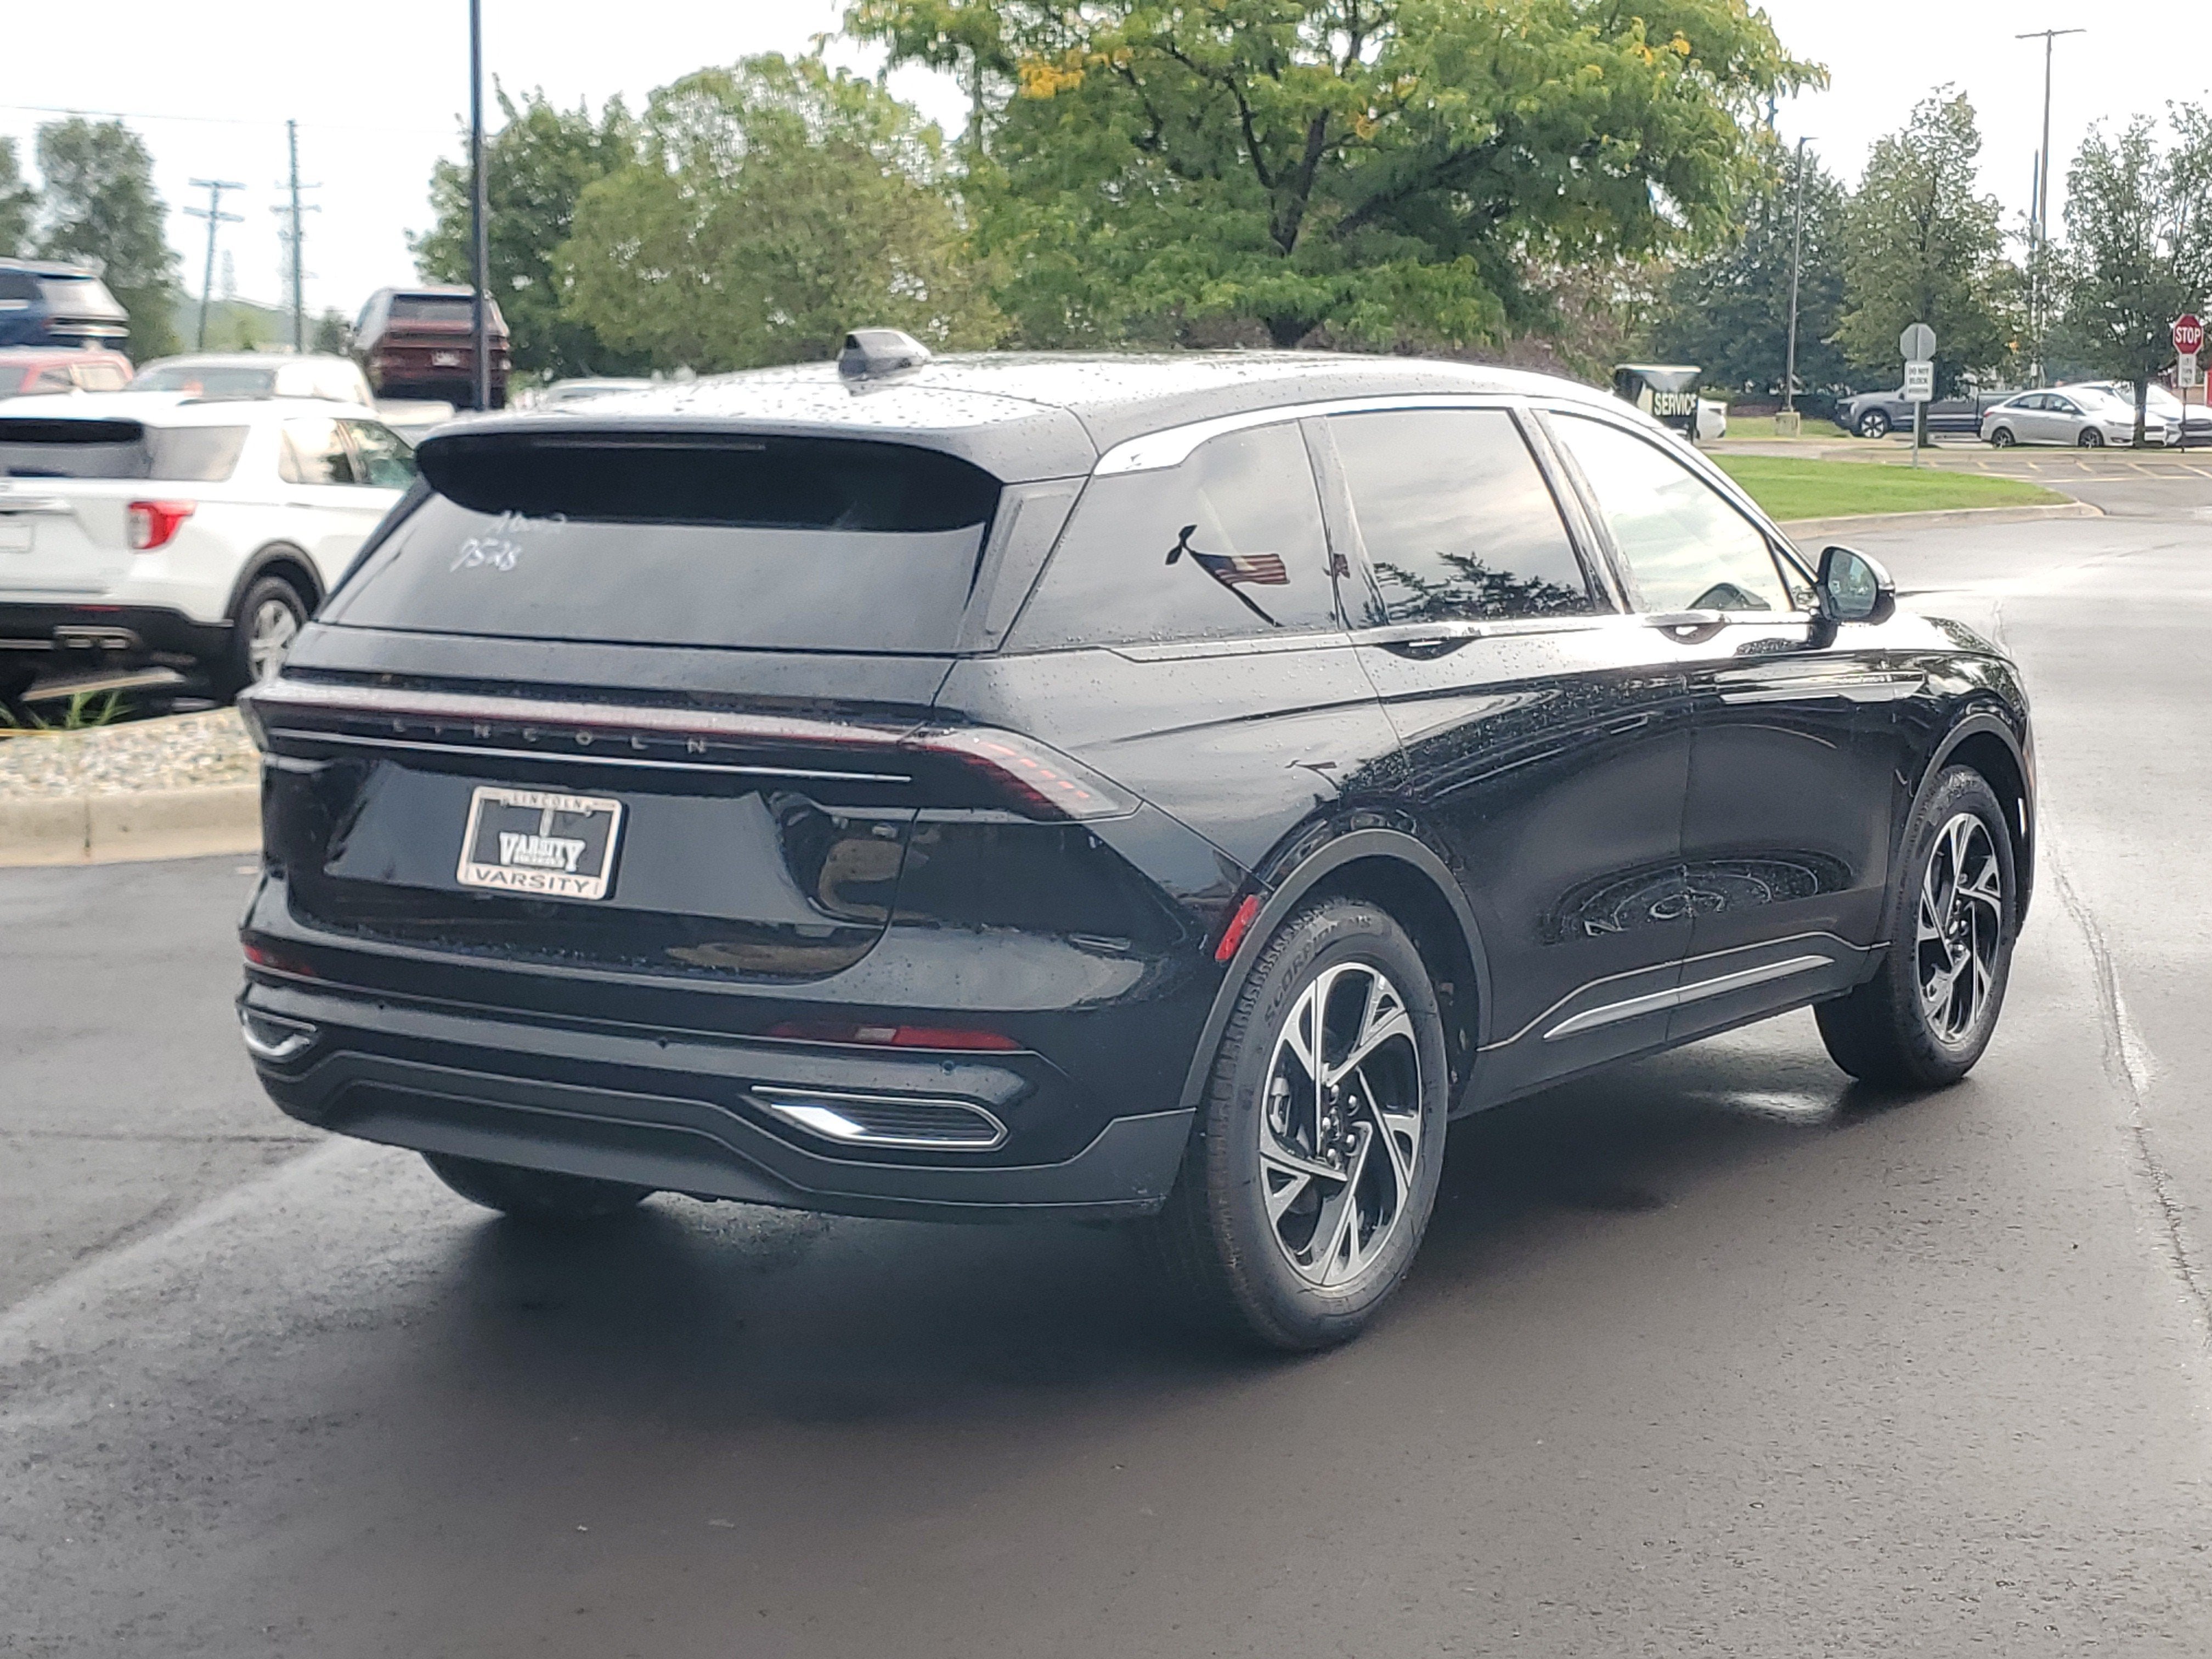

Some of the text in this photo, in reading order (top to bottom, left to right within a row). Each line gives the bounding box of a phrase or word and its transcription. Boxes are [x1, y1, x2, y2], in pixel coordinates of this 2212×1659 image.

[2175, 326, 2201, 344] STOP
[392, 718, 707, 754] LINCOLN
[475, 867, 589, 893] VARSITY
